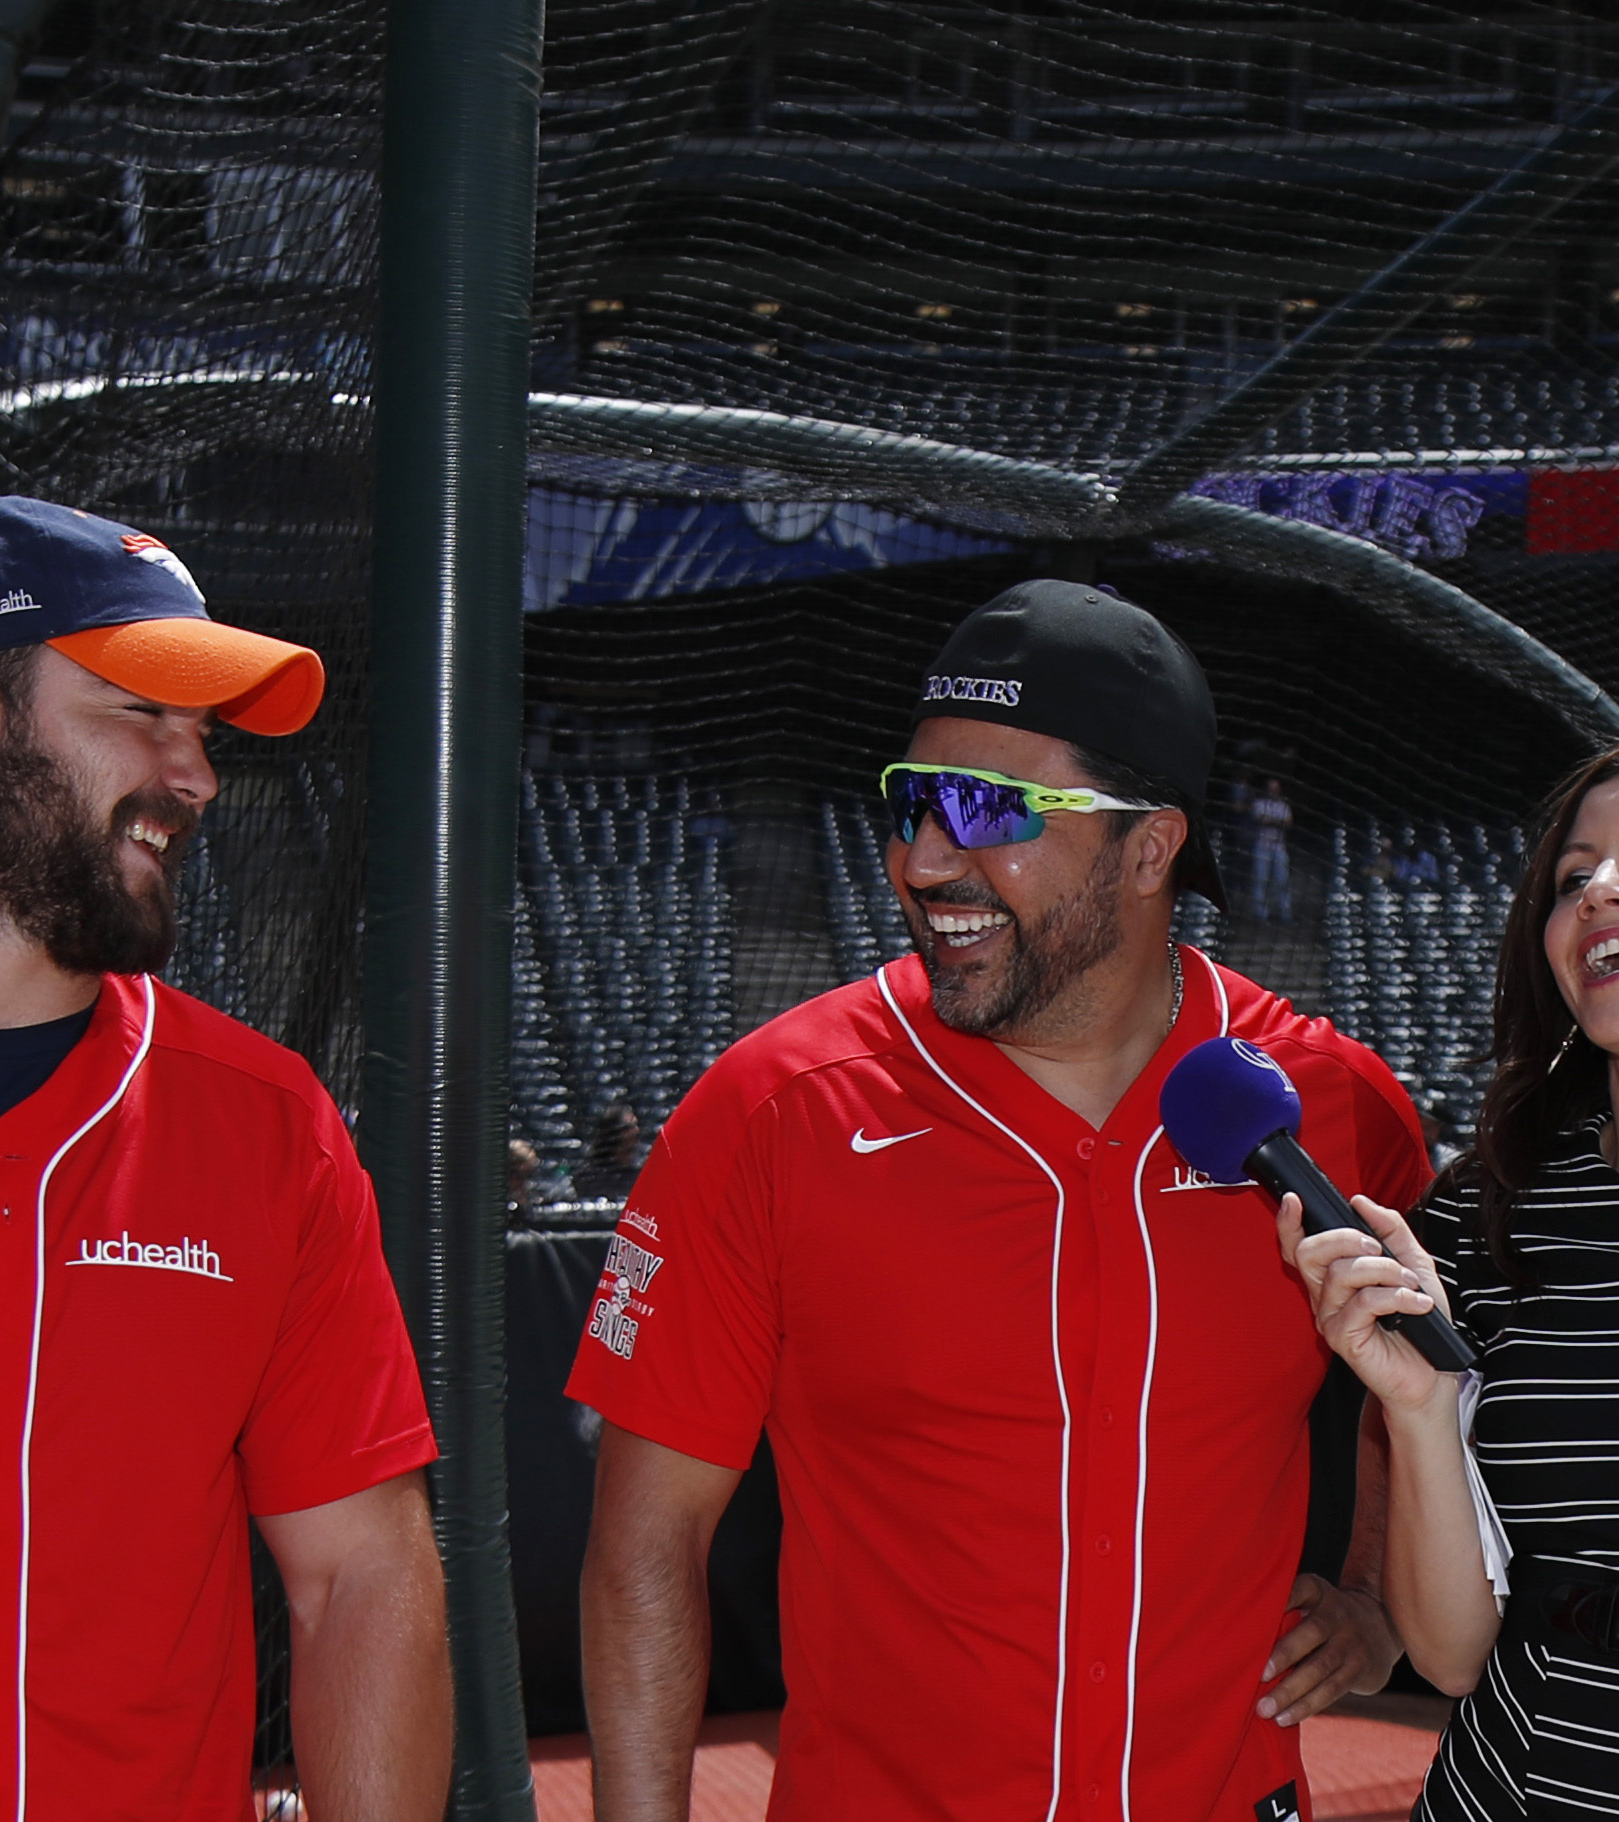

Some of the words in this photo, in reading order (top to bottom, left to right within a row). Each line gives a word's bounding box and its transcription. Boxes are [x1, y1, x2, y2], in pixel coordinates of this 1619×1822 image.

[922, 674, 1024, 708] ROCKIES
[77, 1230, 225, 1278] uchealth
[604, 1232, 665, 1294] HEATHY
[588, 1298, 639, 1361] SNGS
[1270, 1798, 1287, 1819] L
